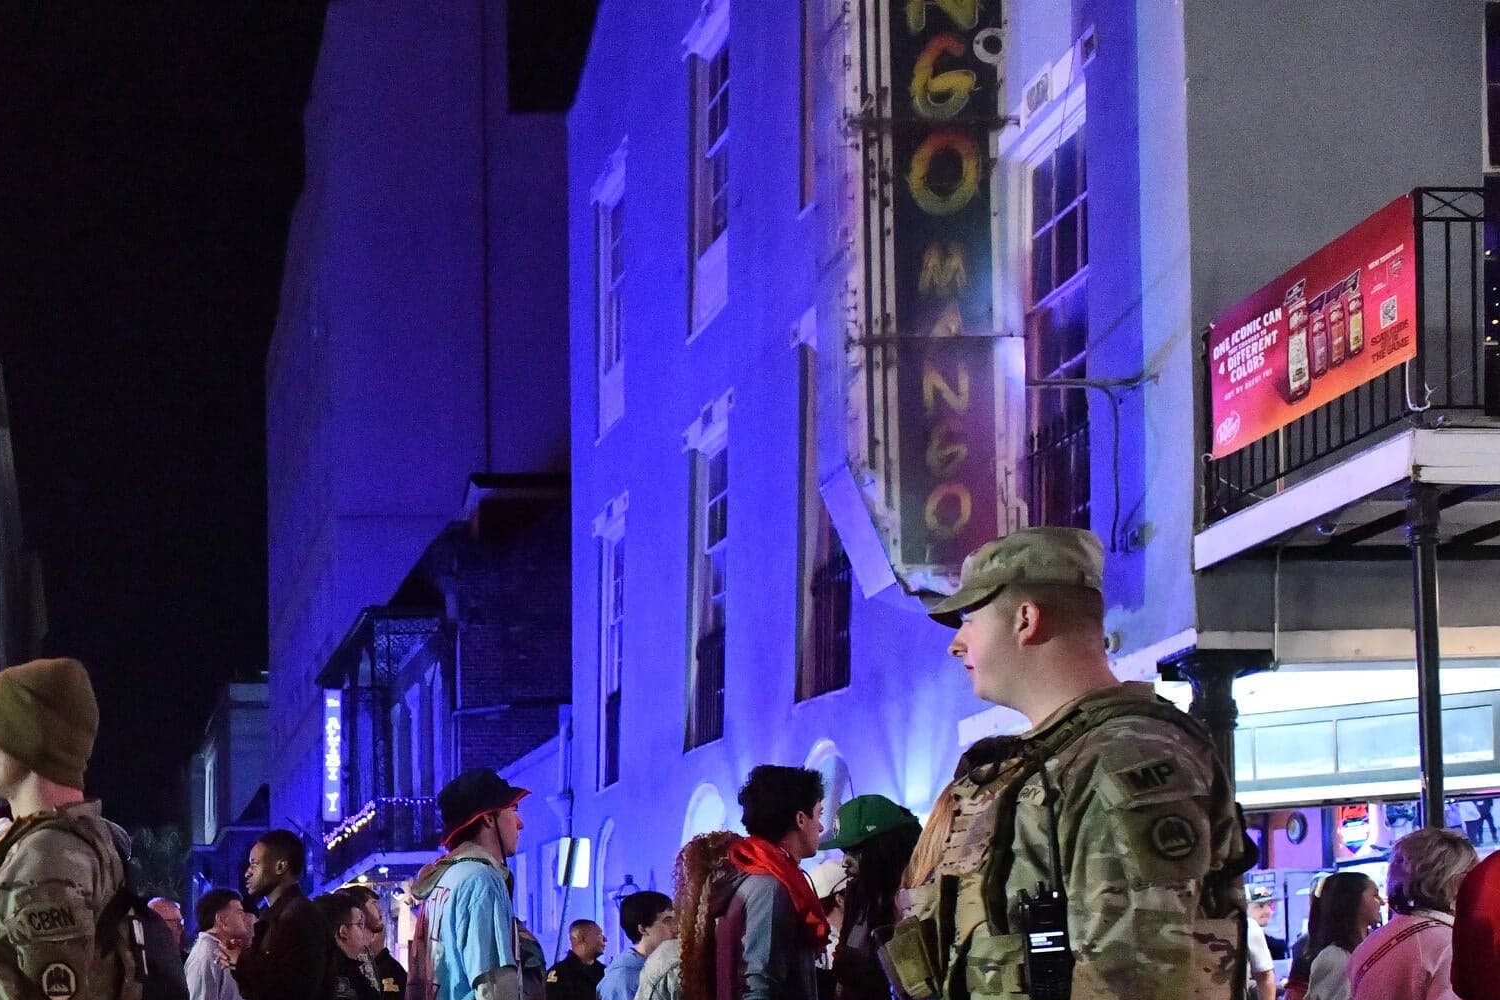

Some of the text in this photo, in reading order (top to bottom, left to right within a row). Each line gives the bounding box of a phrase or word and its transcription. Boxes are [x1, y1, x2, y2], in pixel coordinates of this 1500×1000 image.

[1231, 317, 1262, 346] ICONIC
[1263, 307, 1282, 327] CAN
[1227, 329, 1278, 372] DIFFERENT
[1230, 352, 1265, 383] COLORS
[1127, 763, 1174, 788] MP
[27, 906, 76, 931] CBRN
